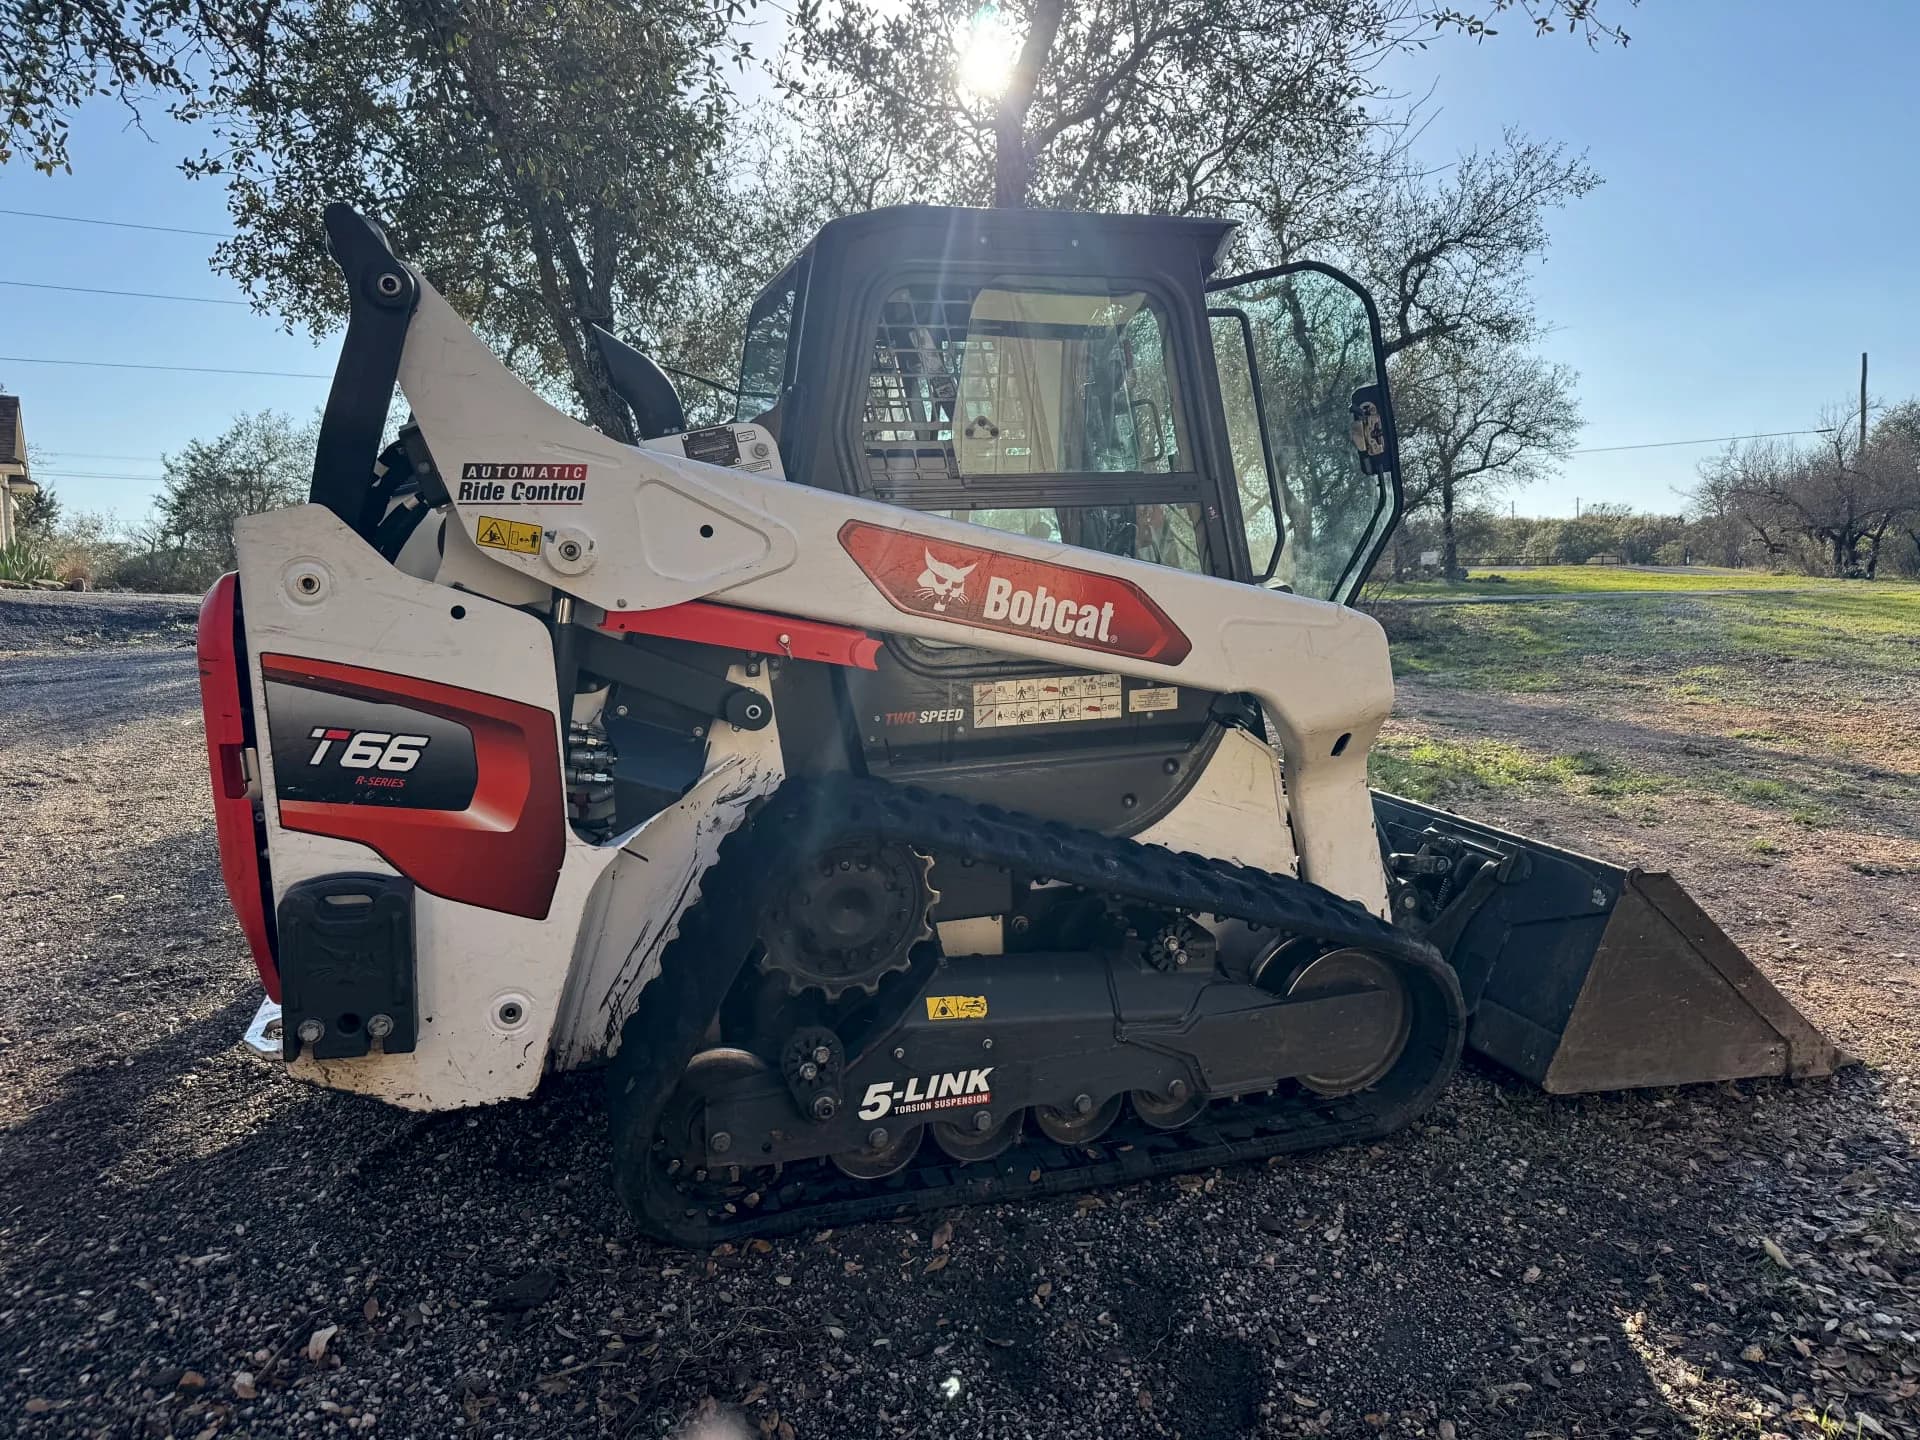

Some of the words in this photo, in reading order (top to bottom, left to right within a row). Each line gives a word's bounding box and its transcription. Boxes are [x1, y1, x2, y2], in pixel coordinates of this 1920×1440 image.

[467, 466, 583, 479] AUTOMATIC
[459, 482, 505, 501] Ride
[511, 482, 586, 501] Control
[983, 576, 1115, 642] Bobcat
[309, 728, 430, 772] T66
[355, 775, 406, 788] R-SERIES
[858, 1067, 995, 1121] 5-LINK
[894, 1102, 932, 1115] TORSION
[934, 1094, 988, 1109] SUSPENSION
